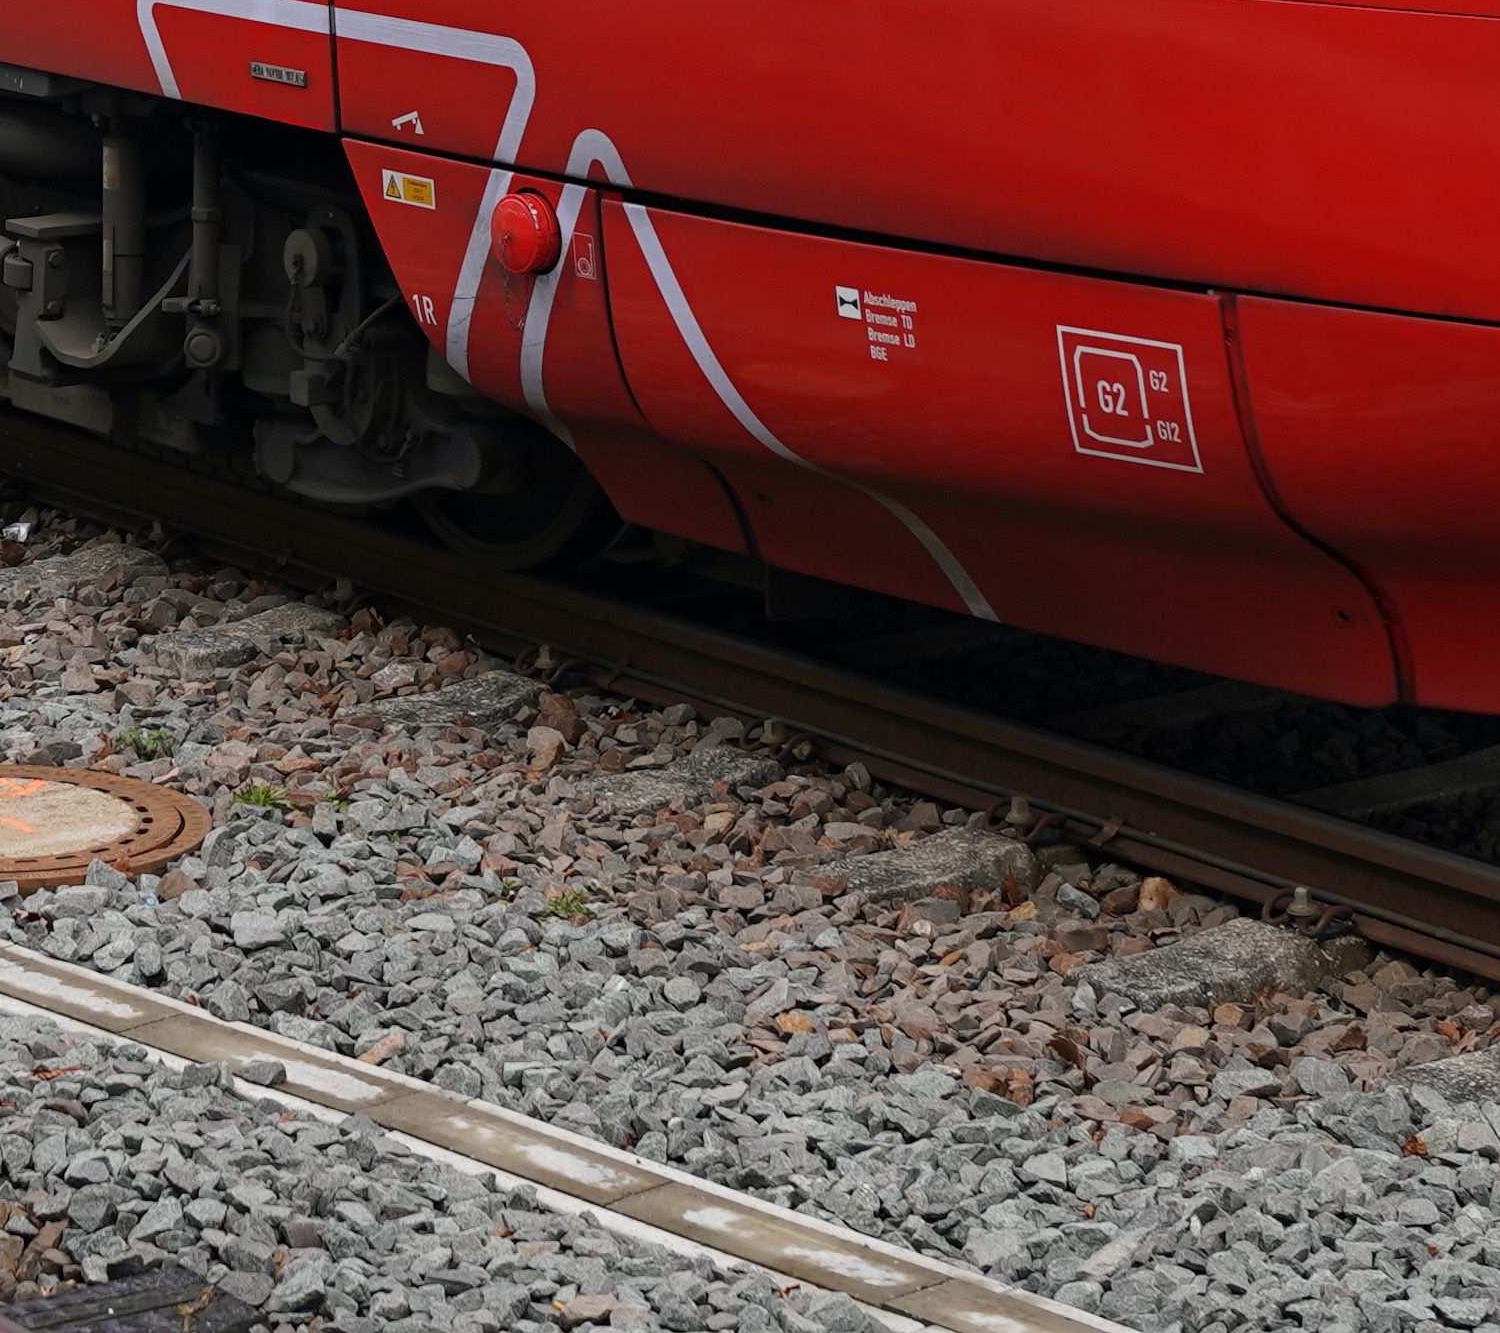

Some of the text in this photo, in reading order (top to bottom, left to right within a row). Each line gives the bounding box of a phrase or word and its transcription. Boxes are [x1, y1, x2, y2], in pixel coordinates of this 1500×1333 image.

[412, 293, 438, 326] 1R
[864, 290, 917, 313] Abschleppen
[865, 308, 898, 327] Bremse
[867, 327, 901, 346] Bremse
[1149, 369, 1169, 393] G2
[1096, 379, 1129, 417] G2
